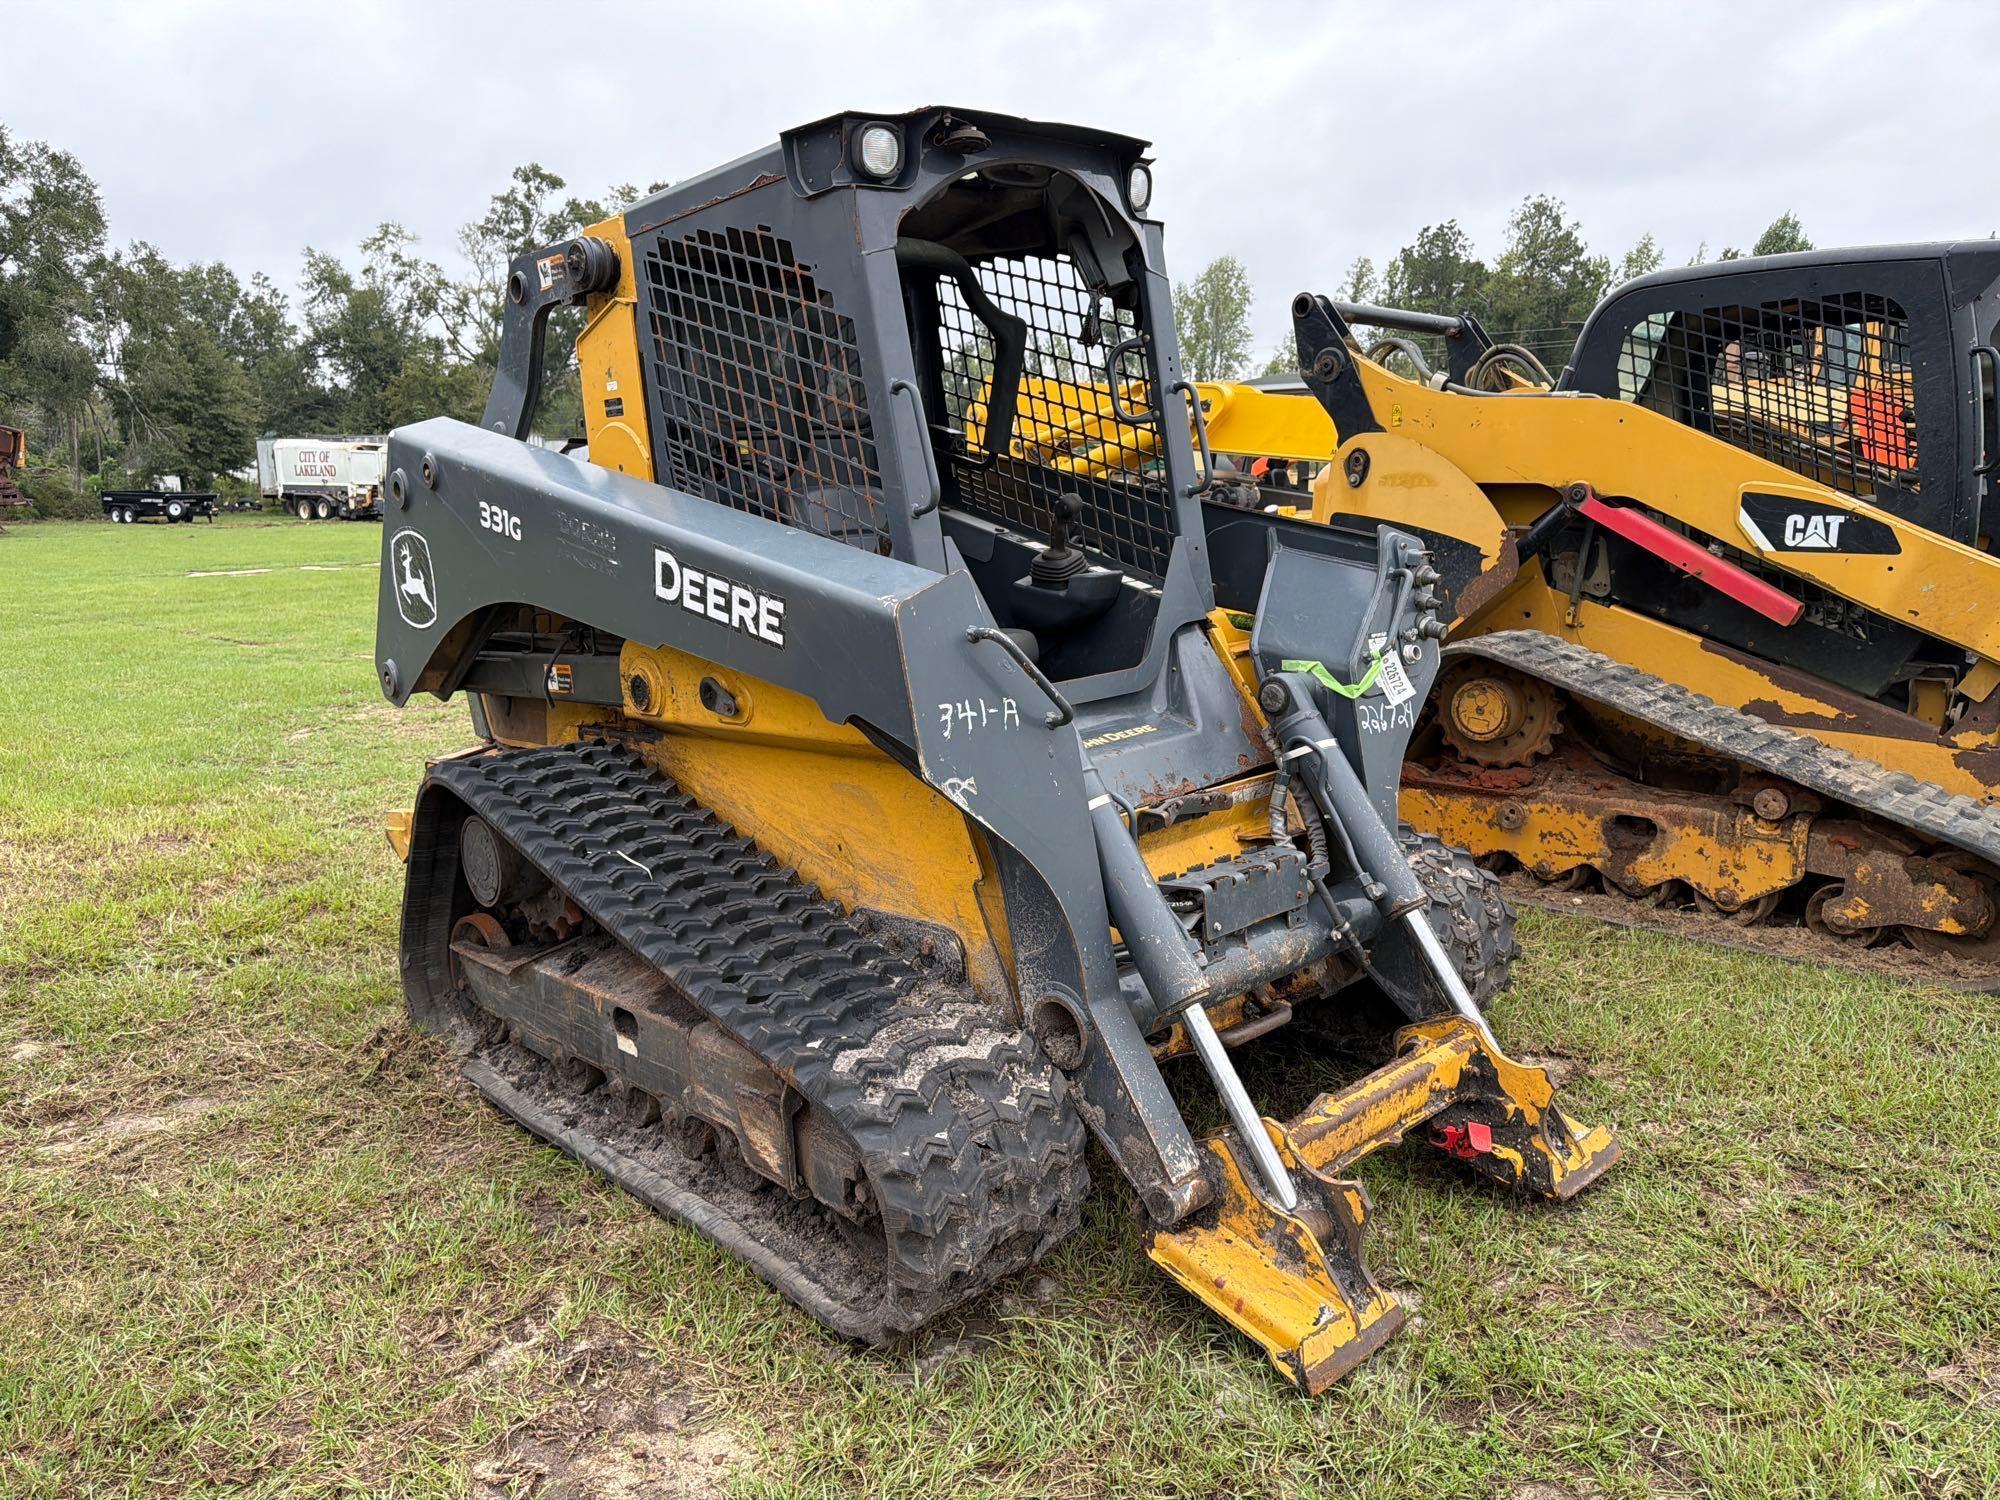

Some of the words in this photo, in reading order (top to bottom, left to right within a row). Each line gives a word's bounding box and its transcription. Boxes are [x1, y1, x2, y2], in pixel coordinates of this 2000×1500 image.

[294, 464, 337, 477] LAKELAND
[299, 450, 317, 463] CITY
[319, 450, 331, 463] OF
[479, 500, 522, 541] 331G
[1784, 514, 1845, 548] CAT
[654, 548, 784, 646] DEERE
[1384, 662, 1408, 696] 226724
[1103, 724, 1158, 741] DEERE
